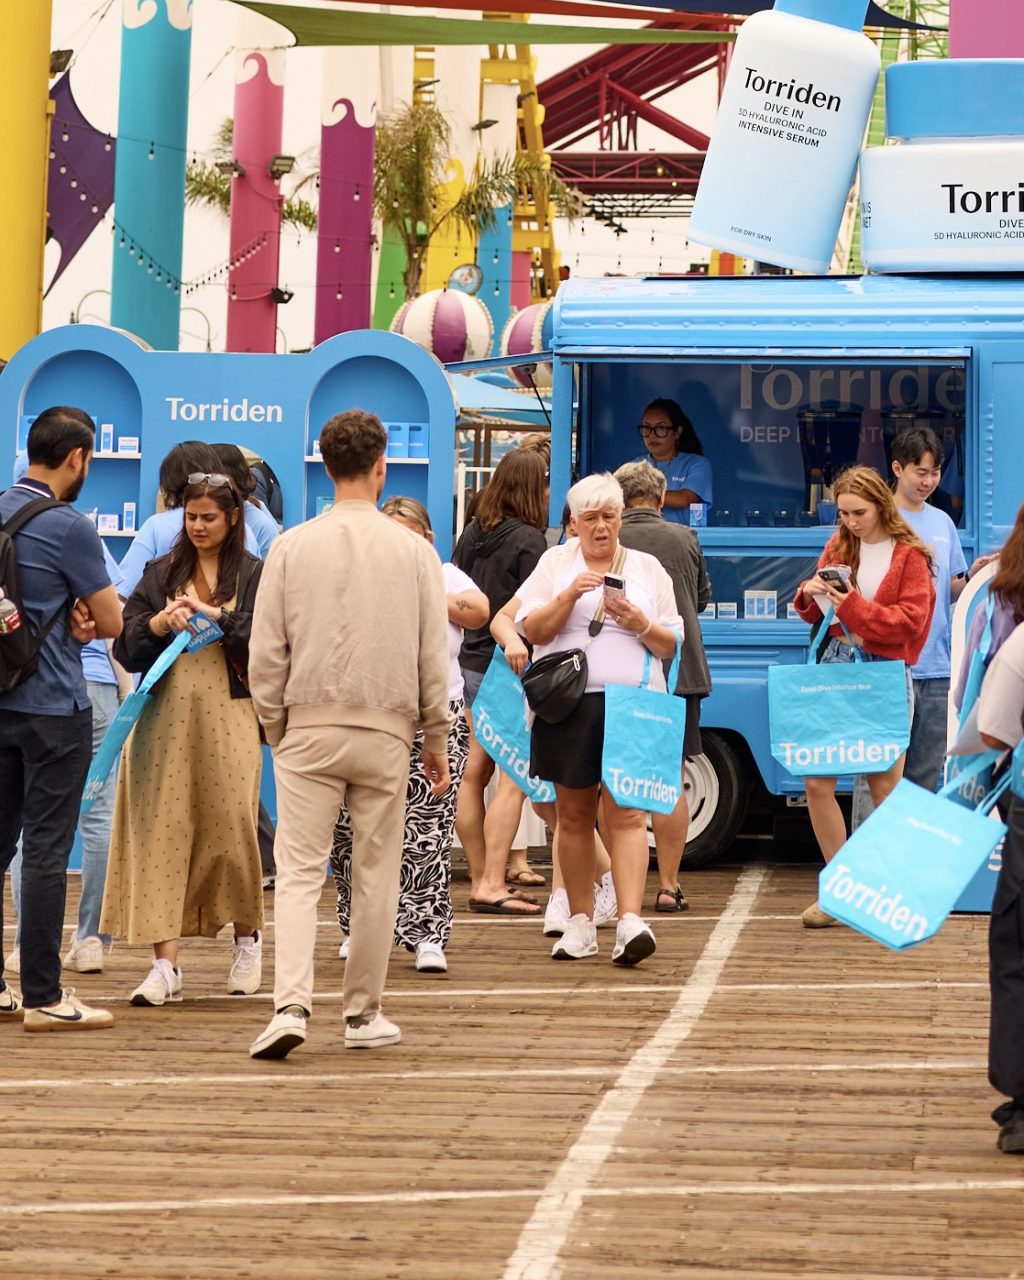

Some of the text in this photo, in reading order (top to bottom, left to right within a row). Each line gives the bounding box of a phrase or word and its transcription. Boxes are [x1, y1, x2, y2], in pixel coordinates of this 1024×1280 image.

[744, 67, 841, 112] Torriden
[763, 101, 804, 120] DIVE IN
[738, 120, 820, 148] INTENSIVE SERUM
[748, 111, 805, 132] HYALURONIC
[806, 126, 827, 138] ACID
[946, 231, 1002, 239] HYALURONIC
[1003, 231, 1024, 239] ACID
[999, 219, 1024, 229] DIVE
[165, 397, 283, 422] Torriden
[740, 426, 791, 443] DEEP
[778, 739, 900, 767] Torriden
[608, 767, 679, 806] Torriden
[823, 862, 929, 942] Torriden
